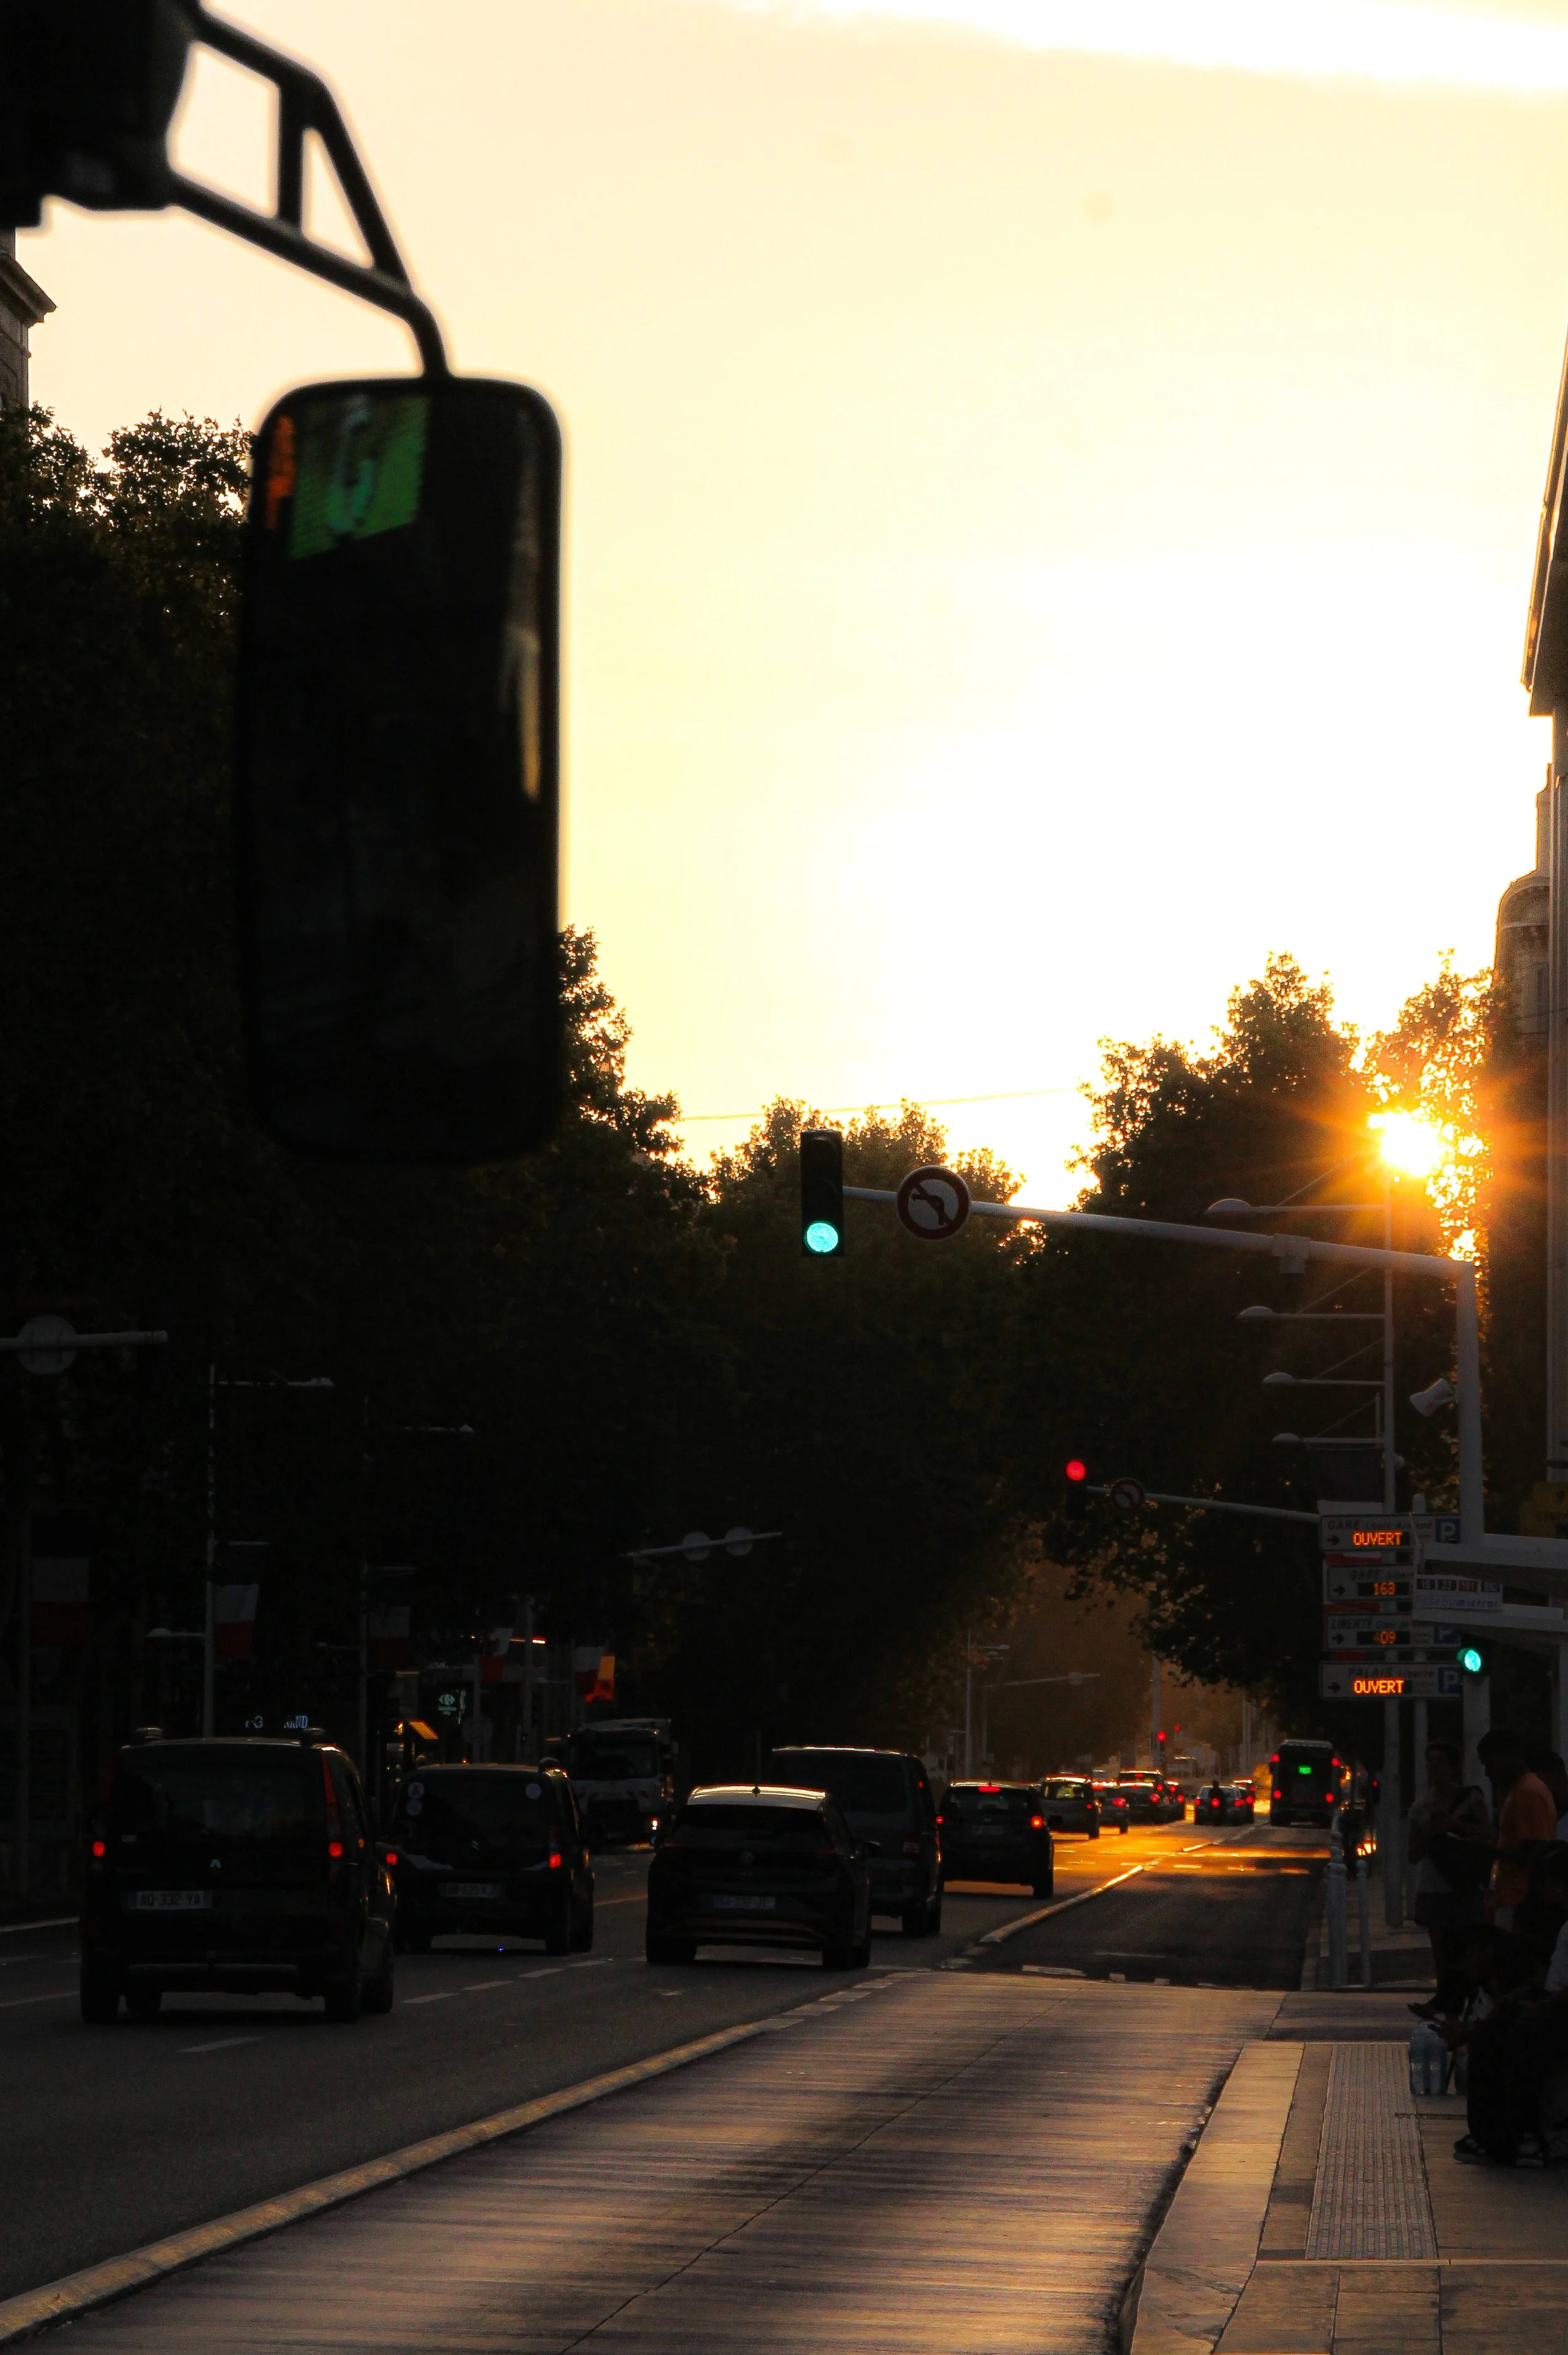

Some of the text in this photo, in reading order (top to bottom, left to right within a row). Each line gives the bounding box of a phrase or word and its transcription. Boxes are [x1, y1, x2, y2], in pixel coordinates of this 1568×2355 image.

[1328, 1520, 1360, 1530] GARE
[1352, 1530, 1402, 1547] OUVERT
[1374, 1580, 1396, 1596] 163
[1352, 1676, 1405, 1696] OUVERT
